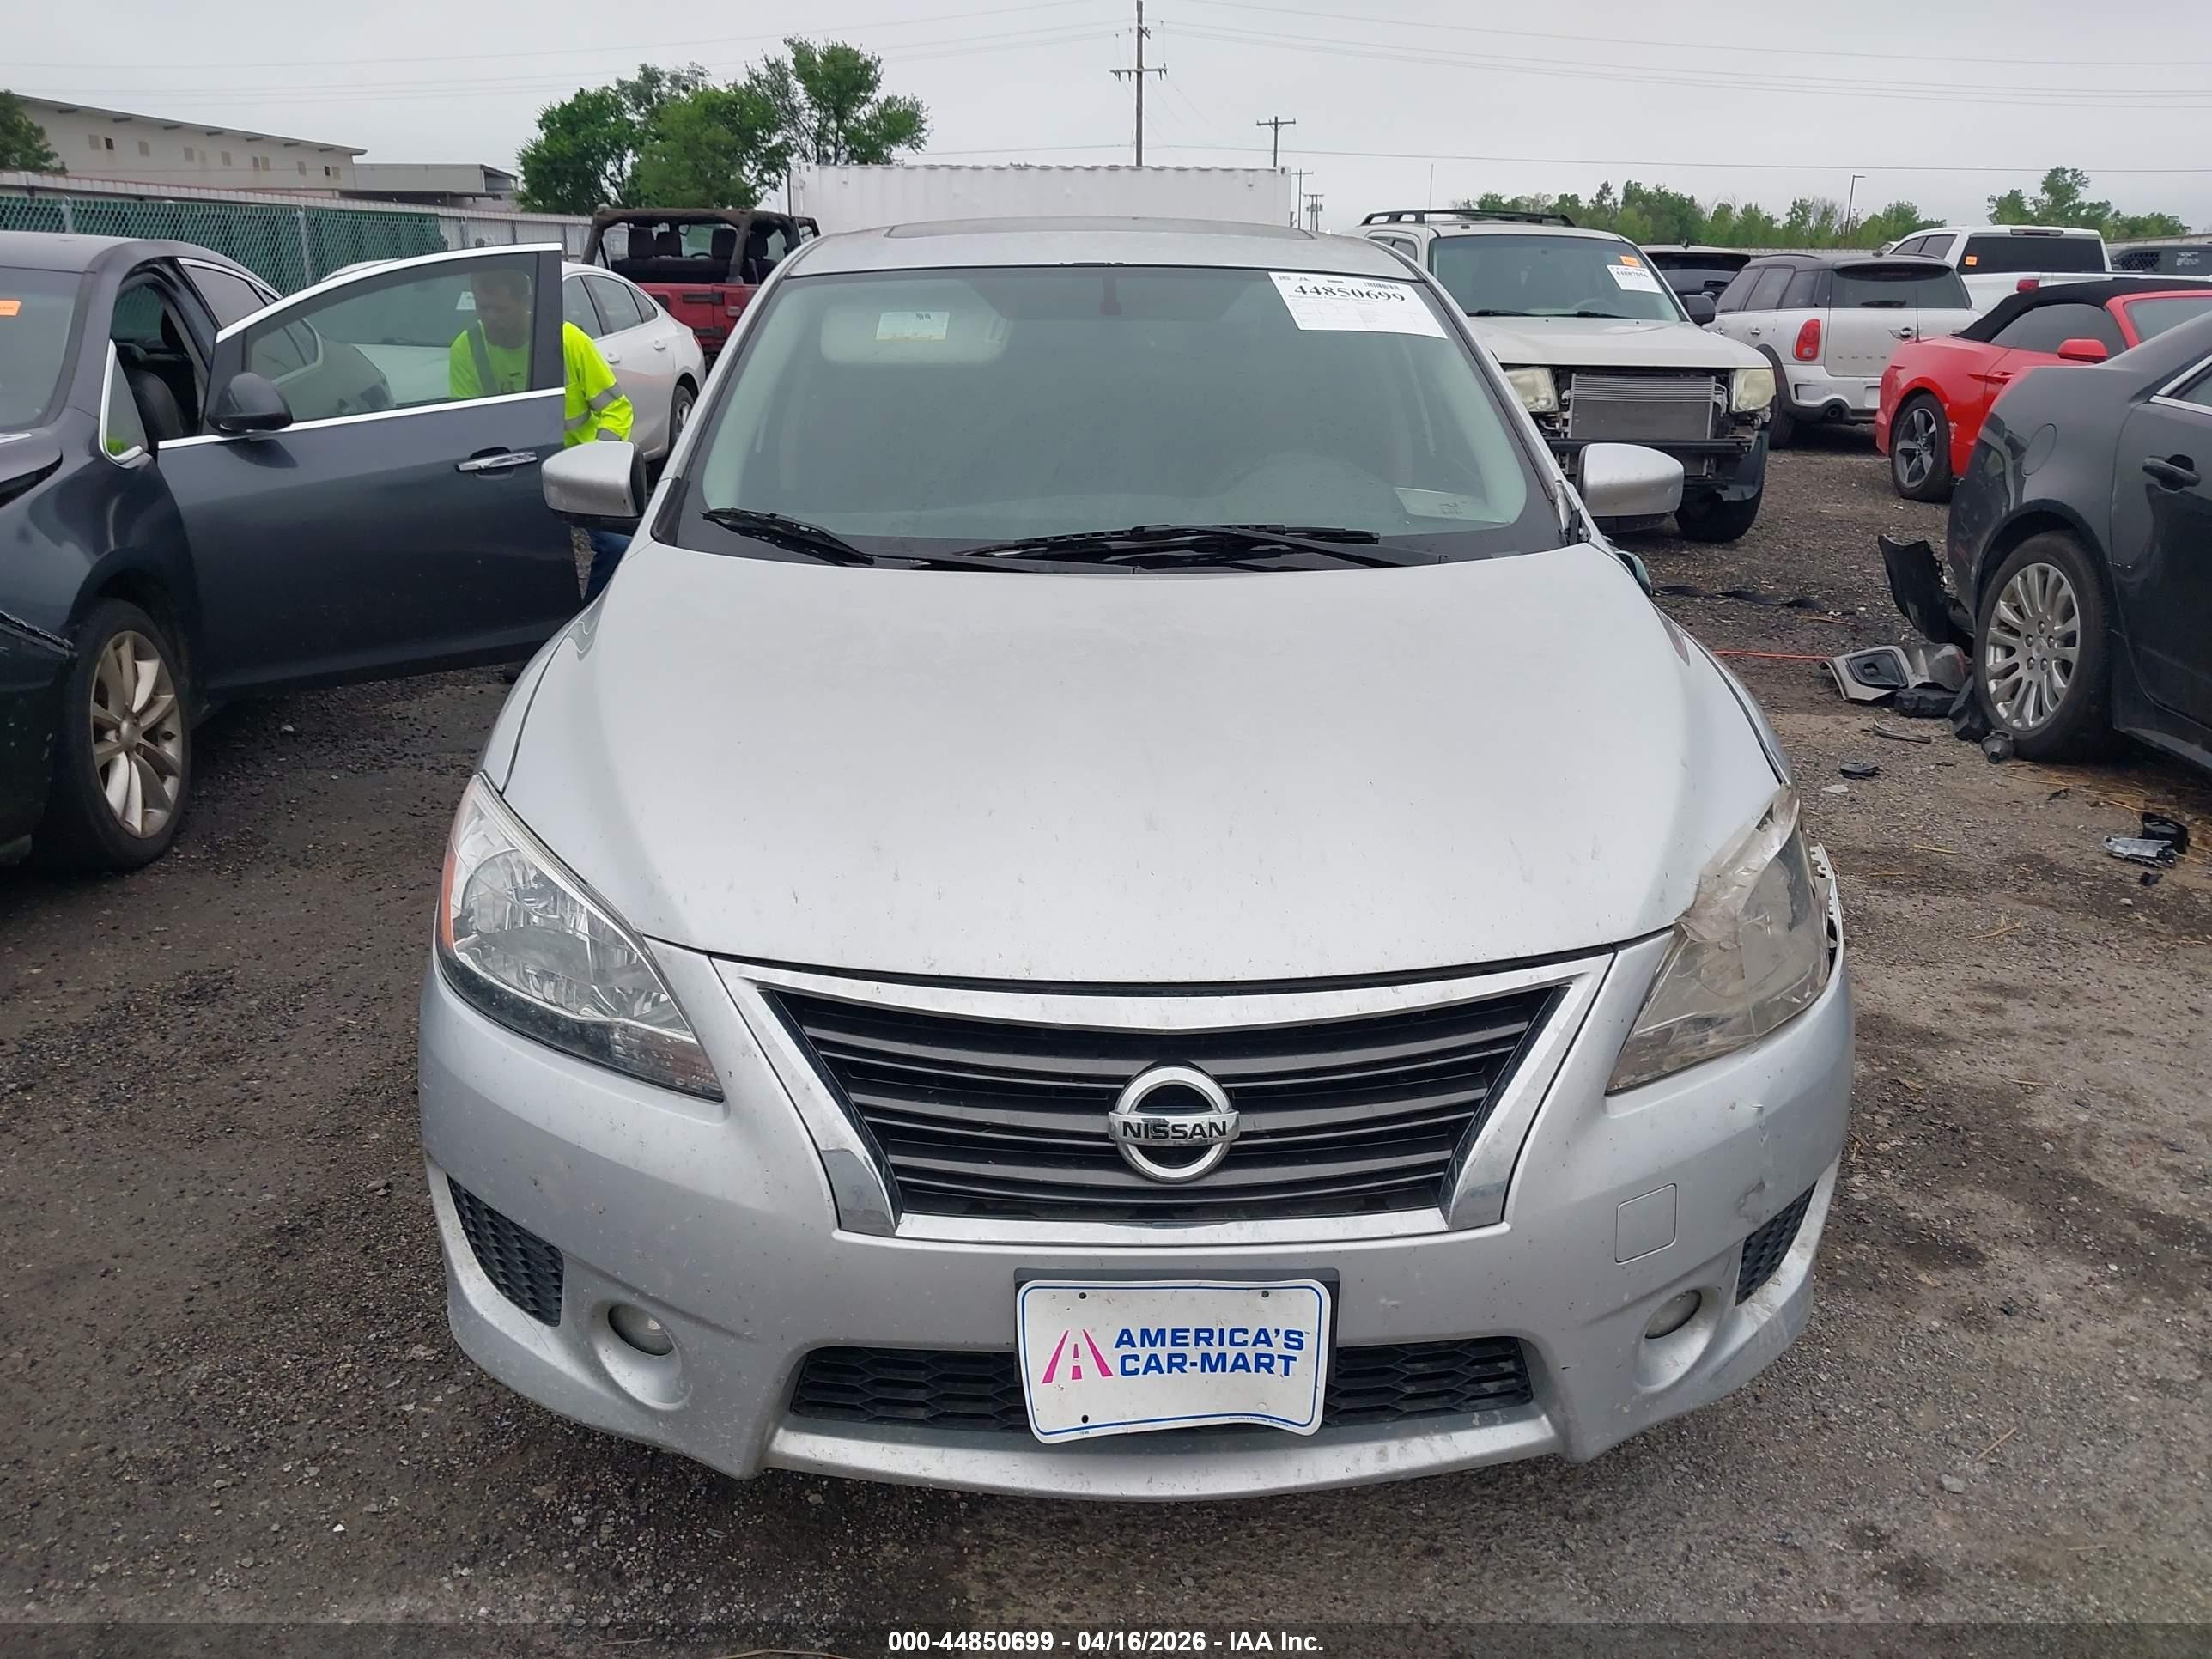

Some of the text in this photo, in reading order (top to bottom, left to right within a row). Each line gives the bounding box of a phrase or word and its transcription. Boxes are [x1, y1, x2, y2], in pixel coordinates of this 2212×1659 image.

[1294, 284, 1406, 301] 44850699
[1122, 1121, 1227, 1139] NISSAN
[1115, 1328, 1304, 1351] AMERICA'S
[1120, 1352, 1297, 1376] CAR-MART
